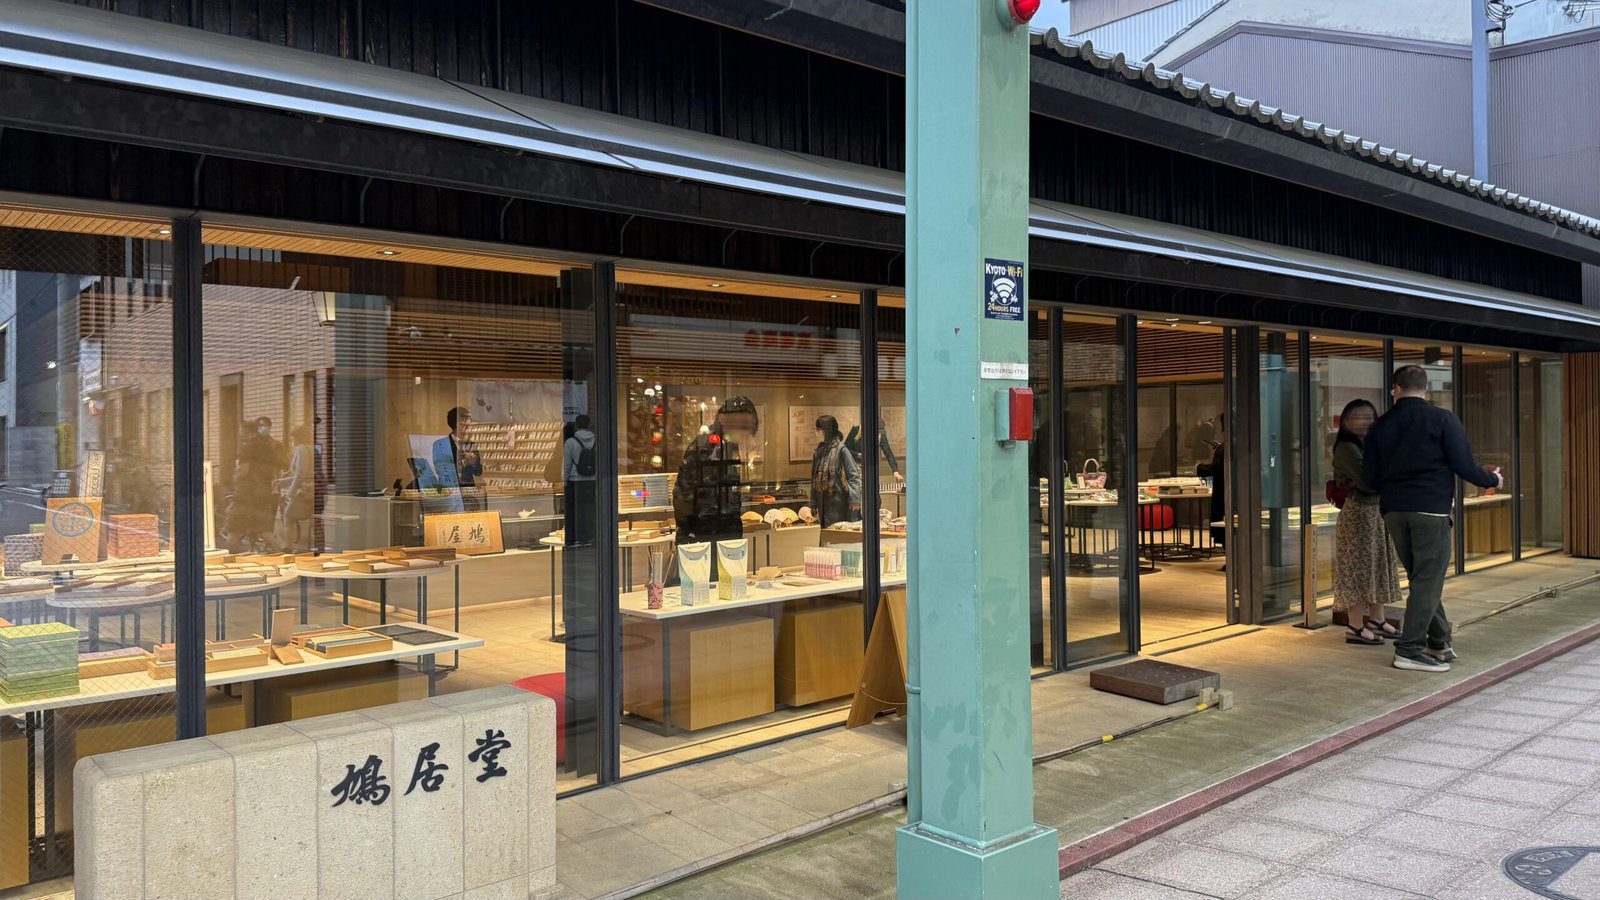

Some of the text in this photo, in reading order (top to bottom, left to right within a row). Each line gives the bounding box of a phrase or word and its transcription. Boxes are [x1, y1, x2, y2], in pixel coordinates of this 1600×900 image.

[985, 262, 1006, 276] KYOTO
[1009, 306, 1021, 314] FREE
[331, 729, 512, 807] 鳩居堂
